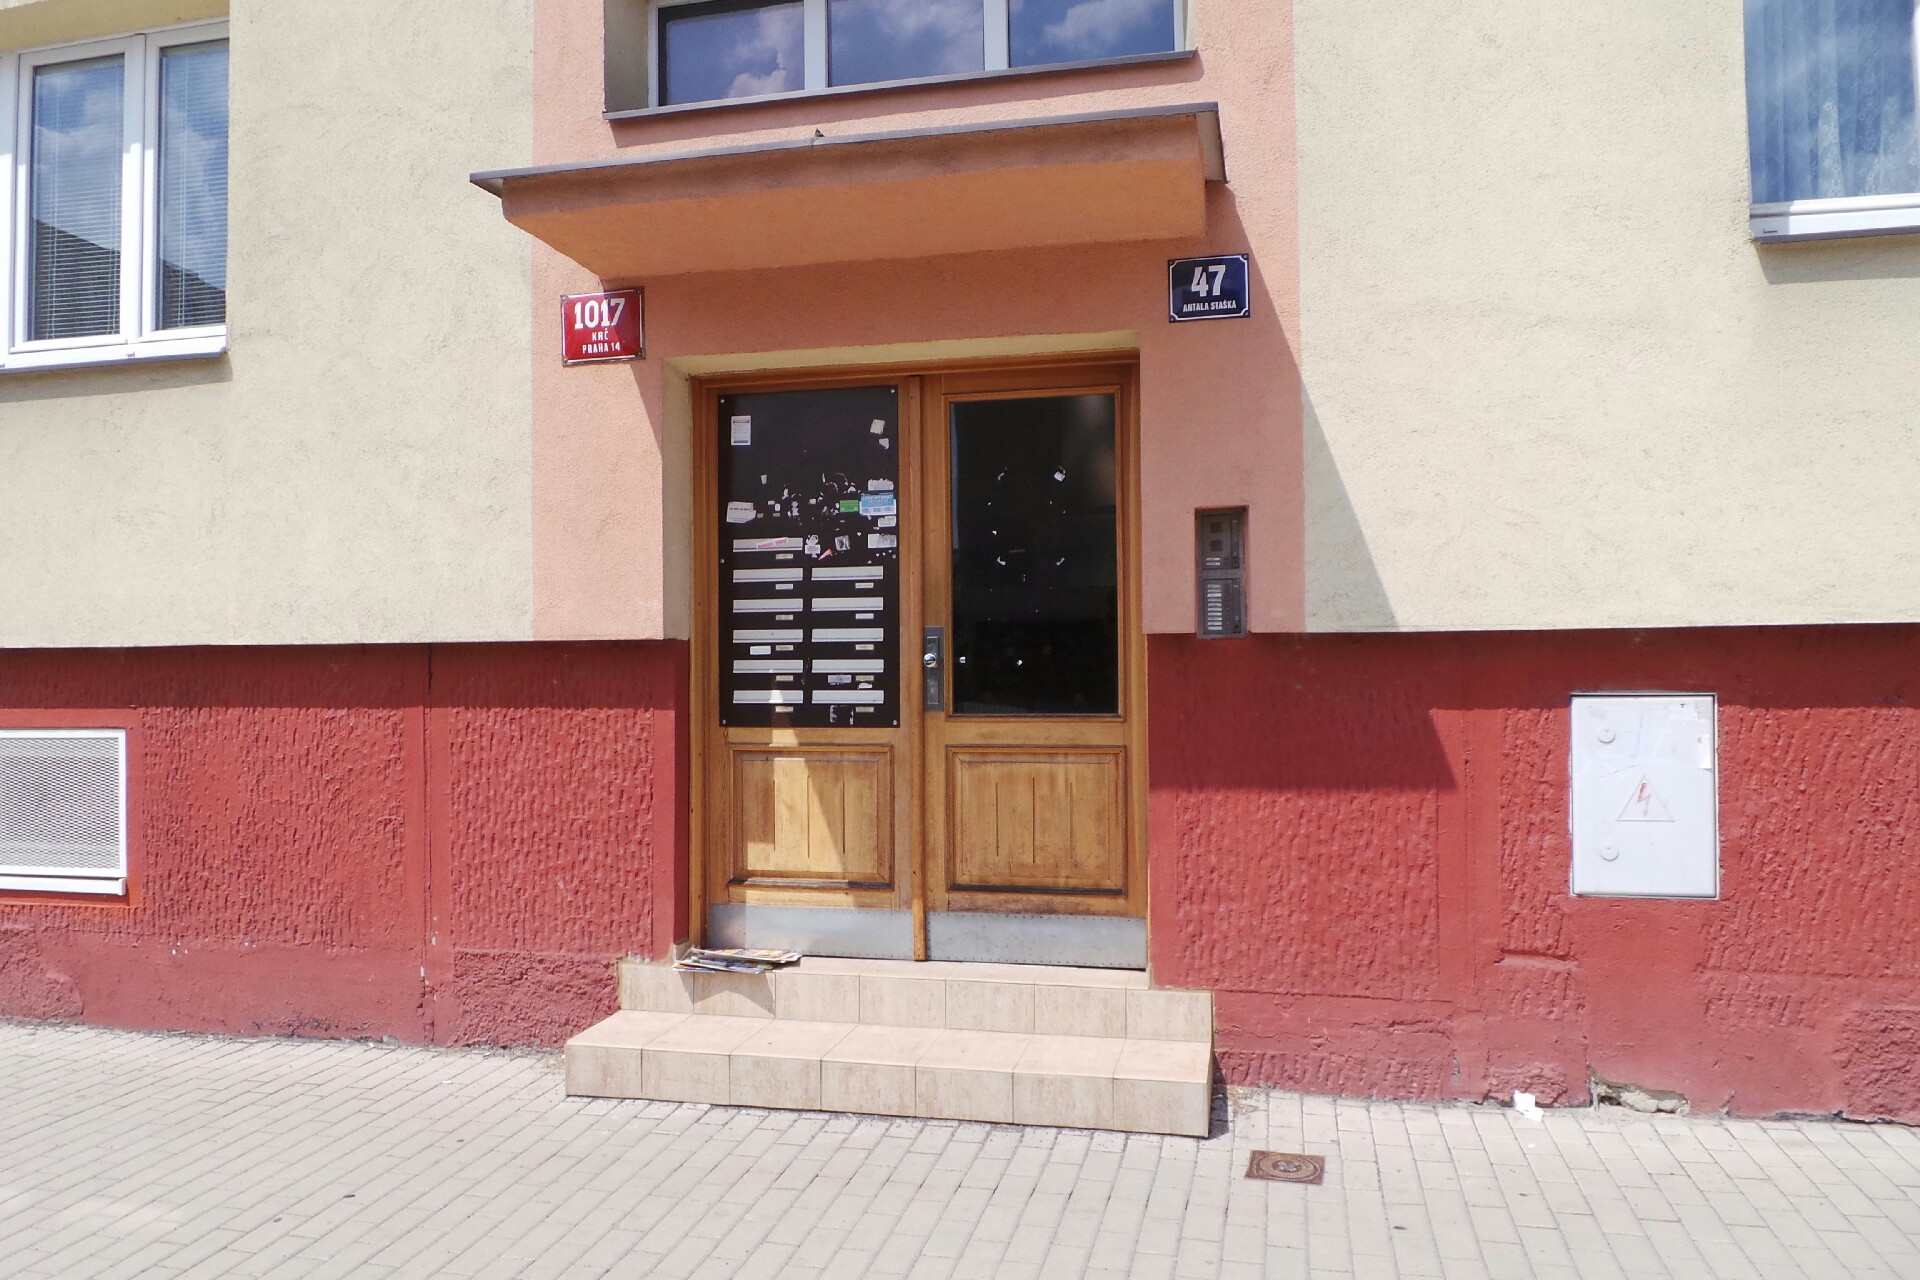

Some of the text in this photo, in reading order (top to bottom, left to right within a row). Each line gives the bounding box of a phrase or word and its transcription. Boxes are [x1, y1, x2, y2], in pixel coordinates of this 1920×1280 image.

[1191, 265, 1226, 297] 47
[1183, 300, 1236, 312] ANTALA STAŠKA
[574, 298, 625, 330] 1017
[592, 328, 609, 340] KRČ
[582, 342, 620, 354] PRAHA 14
